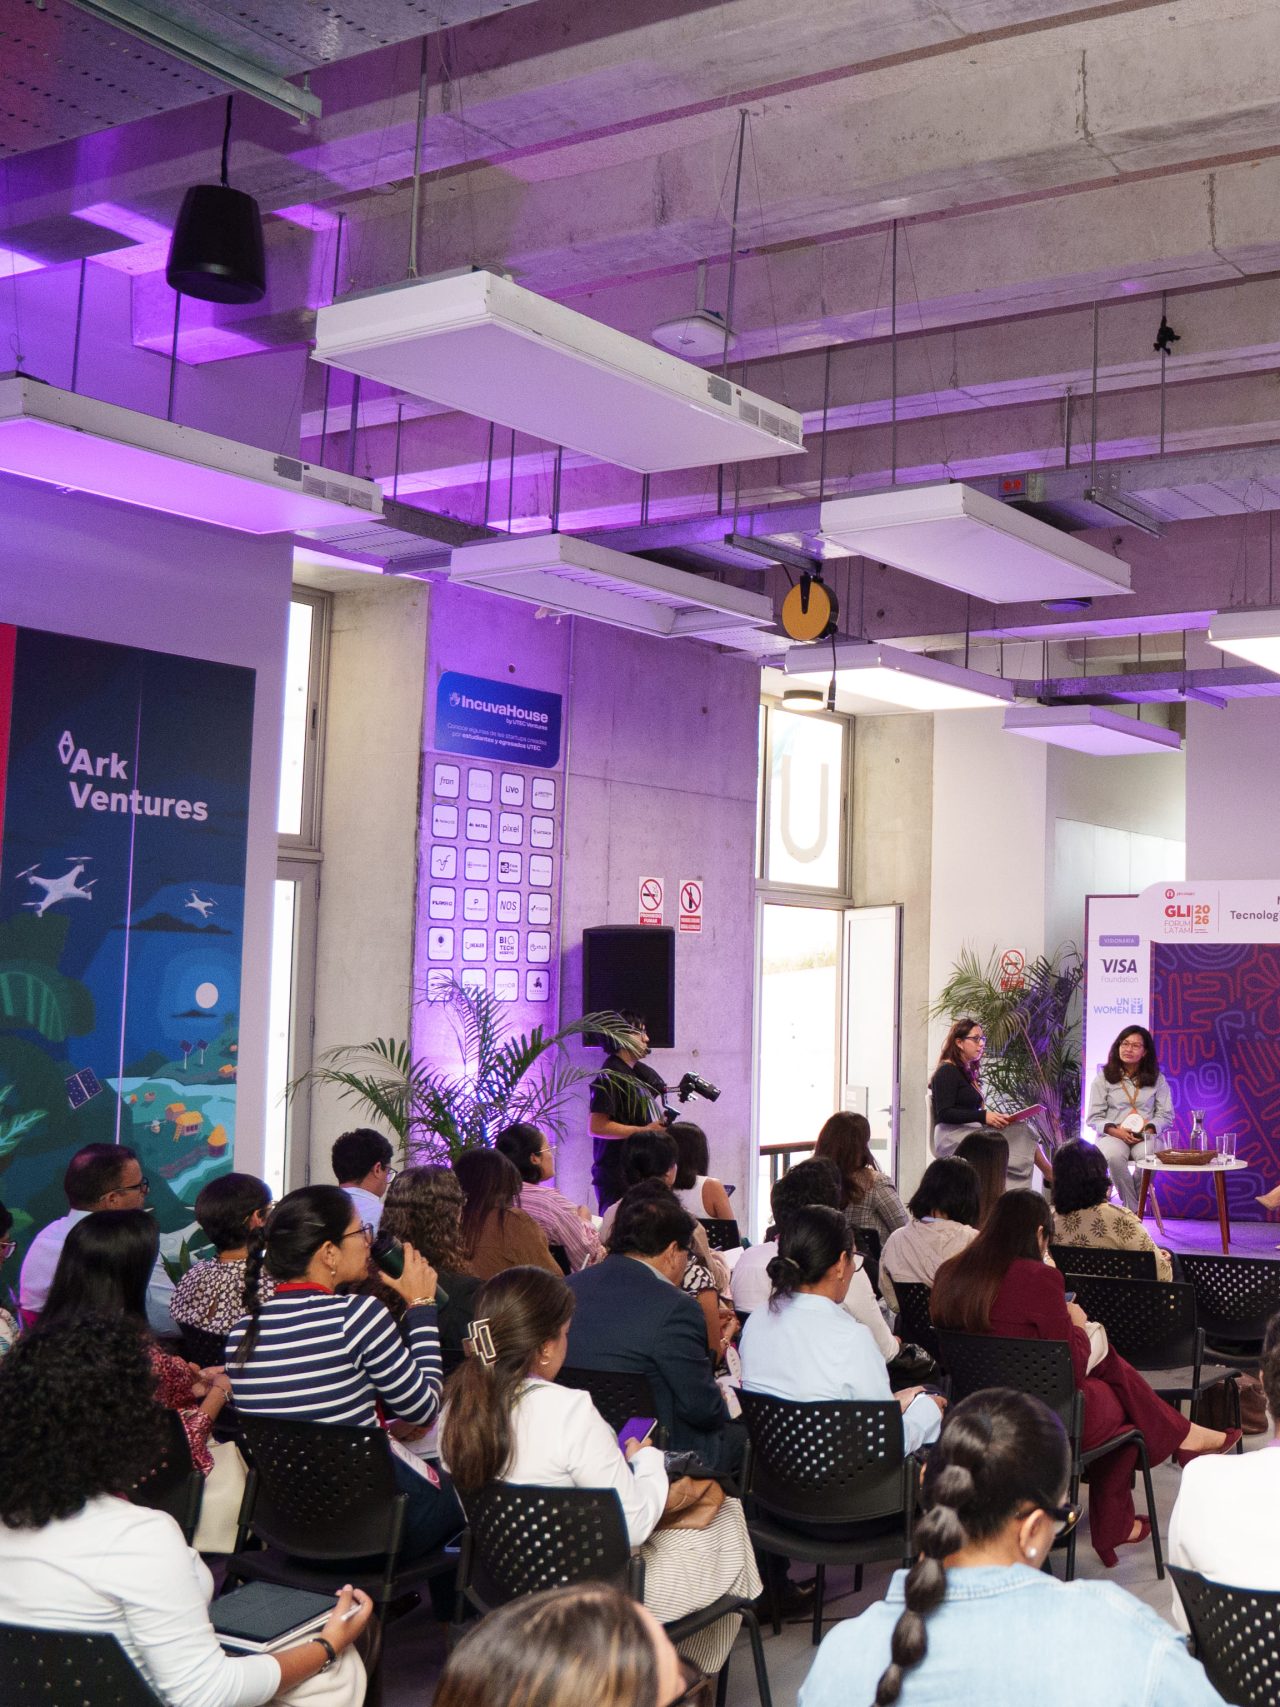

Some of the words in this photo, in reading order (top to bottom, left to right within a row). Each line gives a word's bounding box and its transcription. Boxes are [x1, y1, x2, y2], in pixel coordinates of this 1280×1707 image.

[461, 695, 549, 723] IncuvaHouse
[69, 748, 128, 780] Ark
[69, 781, 208, 821] Ventures
[502, 824, 520, 834] pixel
[500, 900, 517, 911] NOS
[1164, 904, 1191, 918] GLI
[1194, 904, 1210, 914] 20
[1194, 915, 1210, 924] 26
[1100, 959, 1137, 973] VISA
[1093, 1006, 1129, 1014] WOMEN
